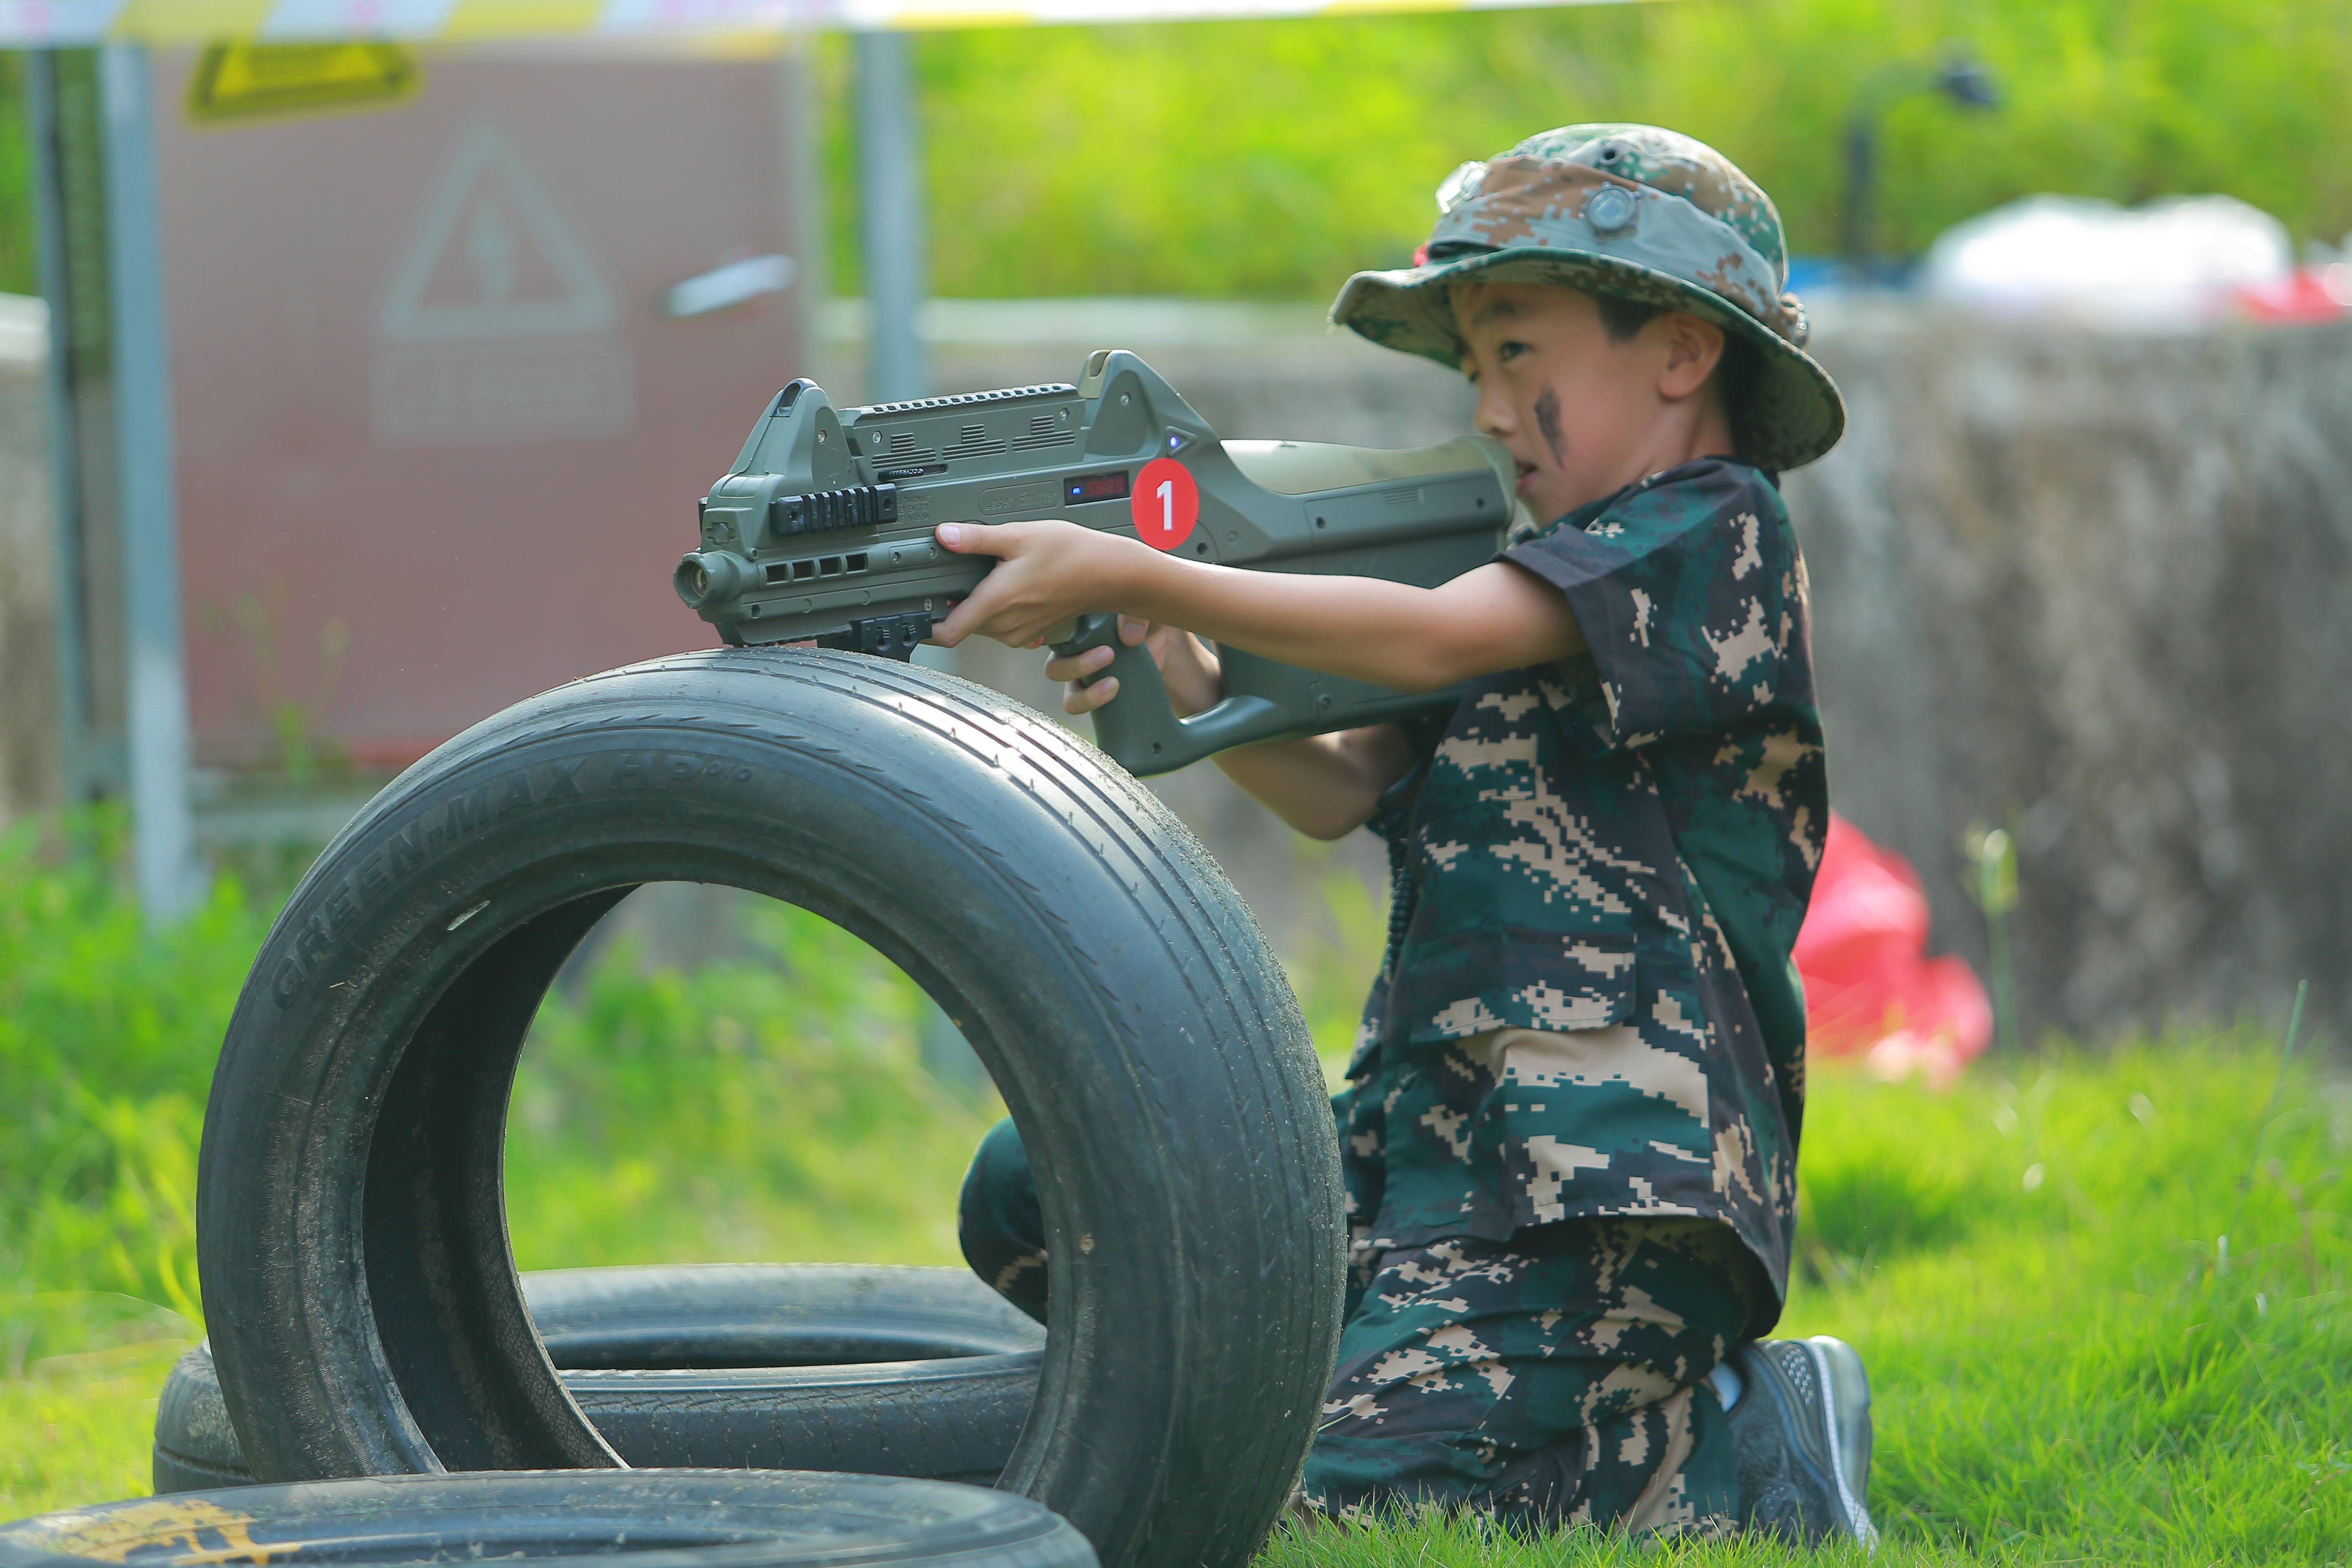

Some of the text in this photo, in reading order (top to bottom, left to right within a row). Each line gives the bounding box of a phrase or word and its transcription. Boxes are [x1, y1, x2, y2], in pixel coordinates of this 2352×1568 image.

[984, 490, 1058, 510] Laser Emitter
[1156, 480, 1173, 530] 1
[897, 503, 929, 515] SER EMITTER
[915, 513, 930, 522] CHINA
